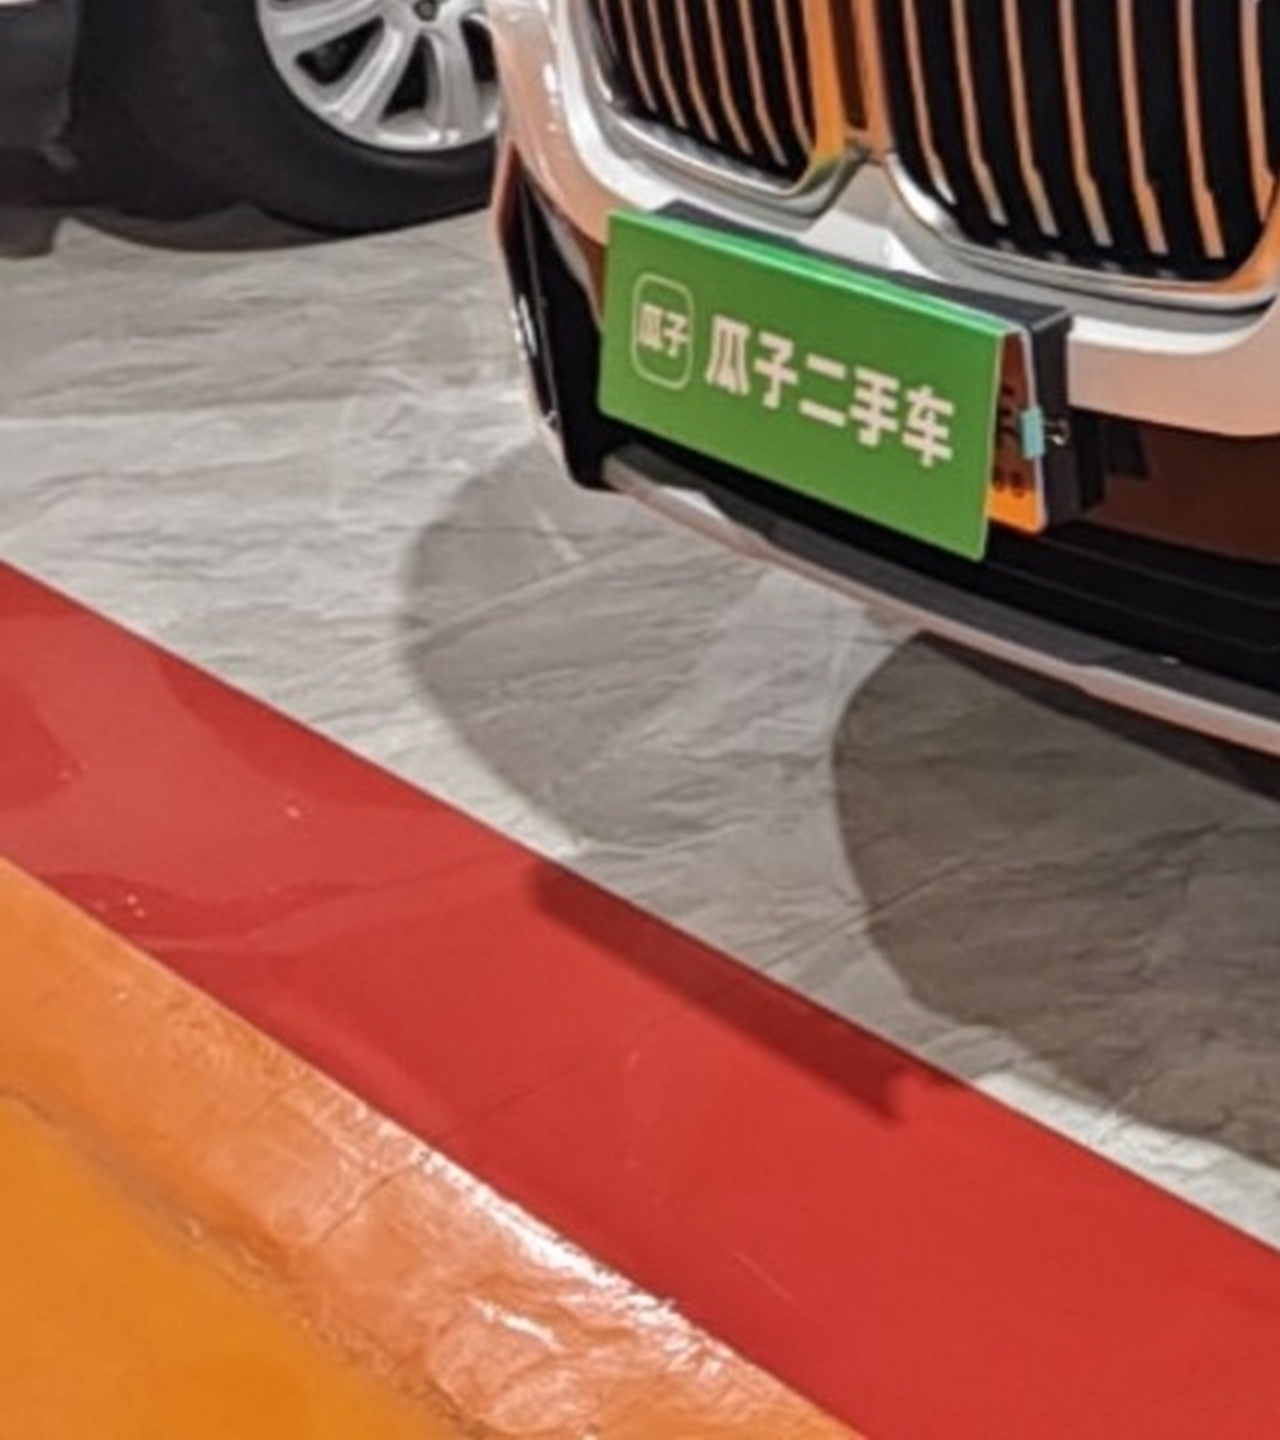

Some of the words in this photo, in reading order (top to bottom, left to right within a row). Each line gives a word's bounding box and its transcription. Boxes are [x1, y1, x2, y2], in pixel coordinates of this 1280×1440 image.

[636, 303, 690, 358] 瓜子
[705, 313, 955, 468] 瓜子二手车
